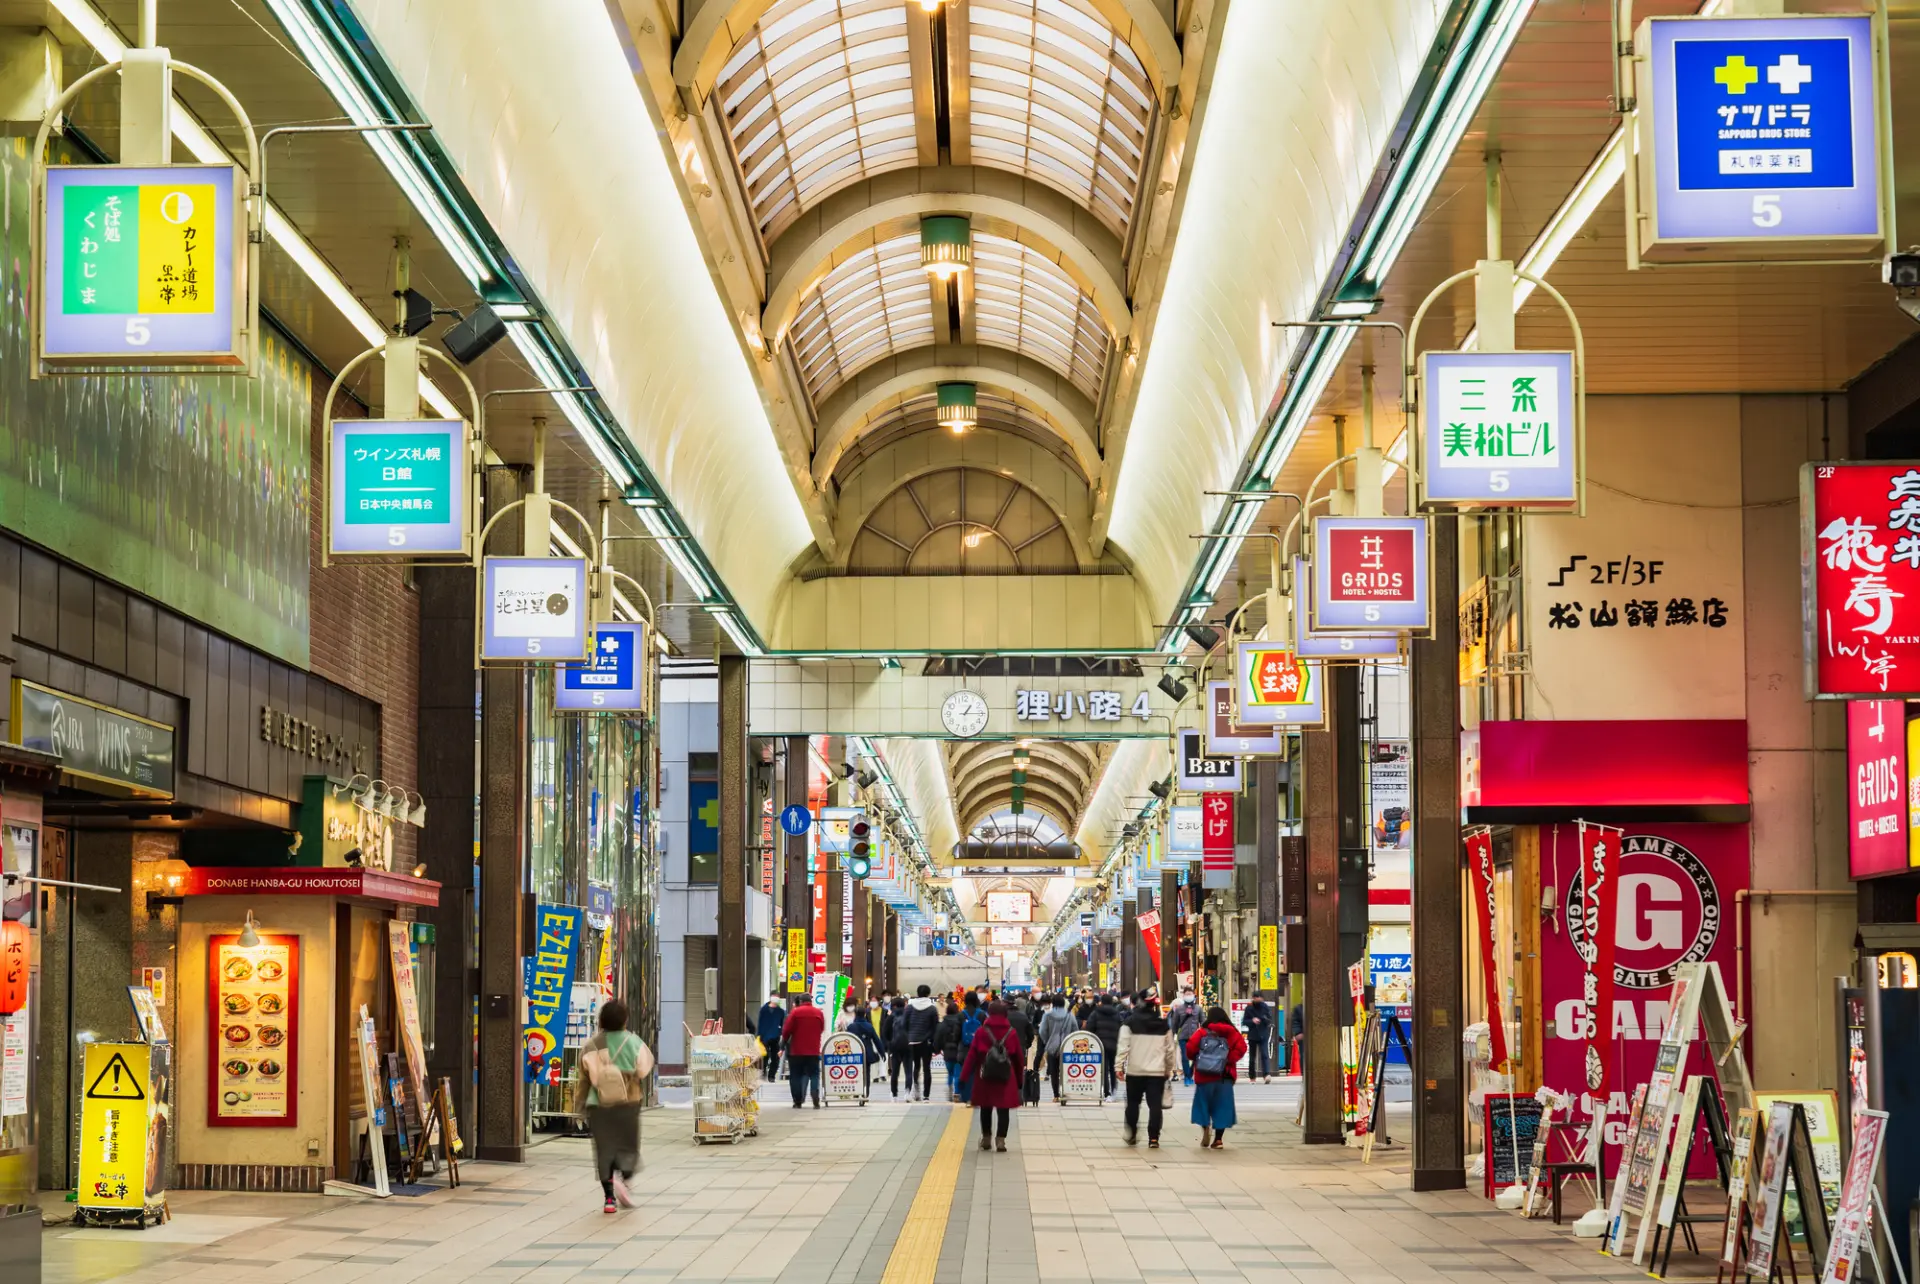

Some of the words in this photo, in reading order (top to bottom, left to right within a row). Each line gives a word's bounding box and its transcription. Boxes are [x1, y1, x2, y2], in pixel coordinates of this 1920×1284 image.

[1717, 104, 1810, 126] サツドラ
[1718, 129, 1758, 139] SAPPORO
[1759, 129, 1782, 139] DRUG
[1784, 128, 1810, 138] STORE
[1730, 154, 1801, 168] 札幌薬粧
[104, 196, 122, 242] そば処
[1752, 195, 1782, 227] 5
[81, 212, 98, 304] くわじま
[182, 226, 198, 301] カレー道場
[158, 264, 179, 304] 黒帯
[125, 318, 150, 346] 5
[1460, 377, 1537, 412] 三条
[1444, 422, 1556, 458] 美松ビル
[354, 447, 441, 461] ウインズ札幌
[382, 468, 412, 481] B館
[1489, 470, 1510, 492] 5
[1818, 467, 1835, 478] 2F
[360, 499, 433, 510] 日本中央競馬会
[388, 526, 406, 546] 5
[1342, 572, 1402, 587] GRIDS
[1590, 555, 1664, 586] 2F/3F
[1819, 516, 1904, 634] 徳寿
[1364, 605, 1380, 621] 5
[1549, 598, 1728, 629] 松山額縁店
[527, 638, 541, 653] 5
[1340, 638, 1354, 650] 5
[1262, 675, 1299, 693] 王将
[592, 692, 605, 705] 5
[1017, 690, 1121, 721] 狸小路
[1131, 690, 1152, 721] 4
[1275, 707, 1287, 719] 5
[66, 717, 84, 752] JRA
[97, 717, 131, 775] WINS
[1240, 740, 1249, 750] 5
[1188, 758, 1231, 774] Bar
[1204, 778, 1215, 787] 5
[1858, 756, 1898, 808] GRIDS
[1209, 792, 1228, 836] やげ
[763, 816, 773, 840] 2nd
[1859, 819, 1874, 838] HOTEL
[1879, 814, 1899, 835] HOSTEL
[1620, 838, 1675, 857] AME
[208, 879, 248, 888] DONABE
[251, 879, 302, 888] HANBA-GU
[305, 879, 360, 888] HOKUTOSEI
[8, 942, 21, 1000] ホッピー
[534, 913, 575, 1010] EZOCA
[1613, 969, 1660, 986] GATE
[826, 1055, 860, 1064] 歩行者専用
[109, 1110, 120, 1162] 旨すぎ注意
[94, 1182, 128, 1200] 黒帯
